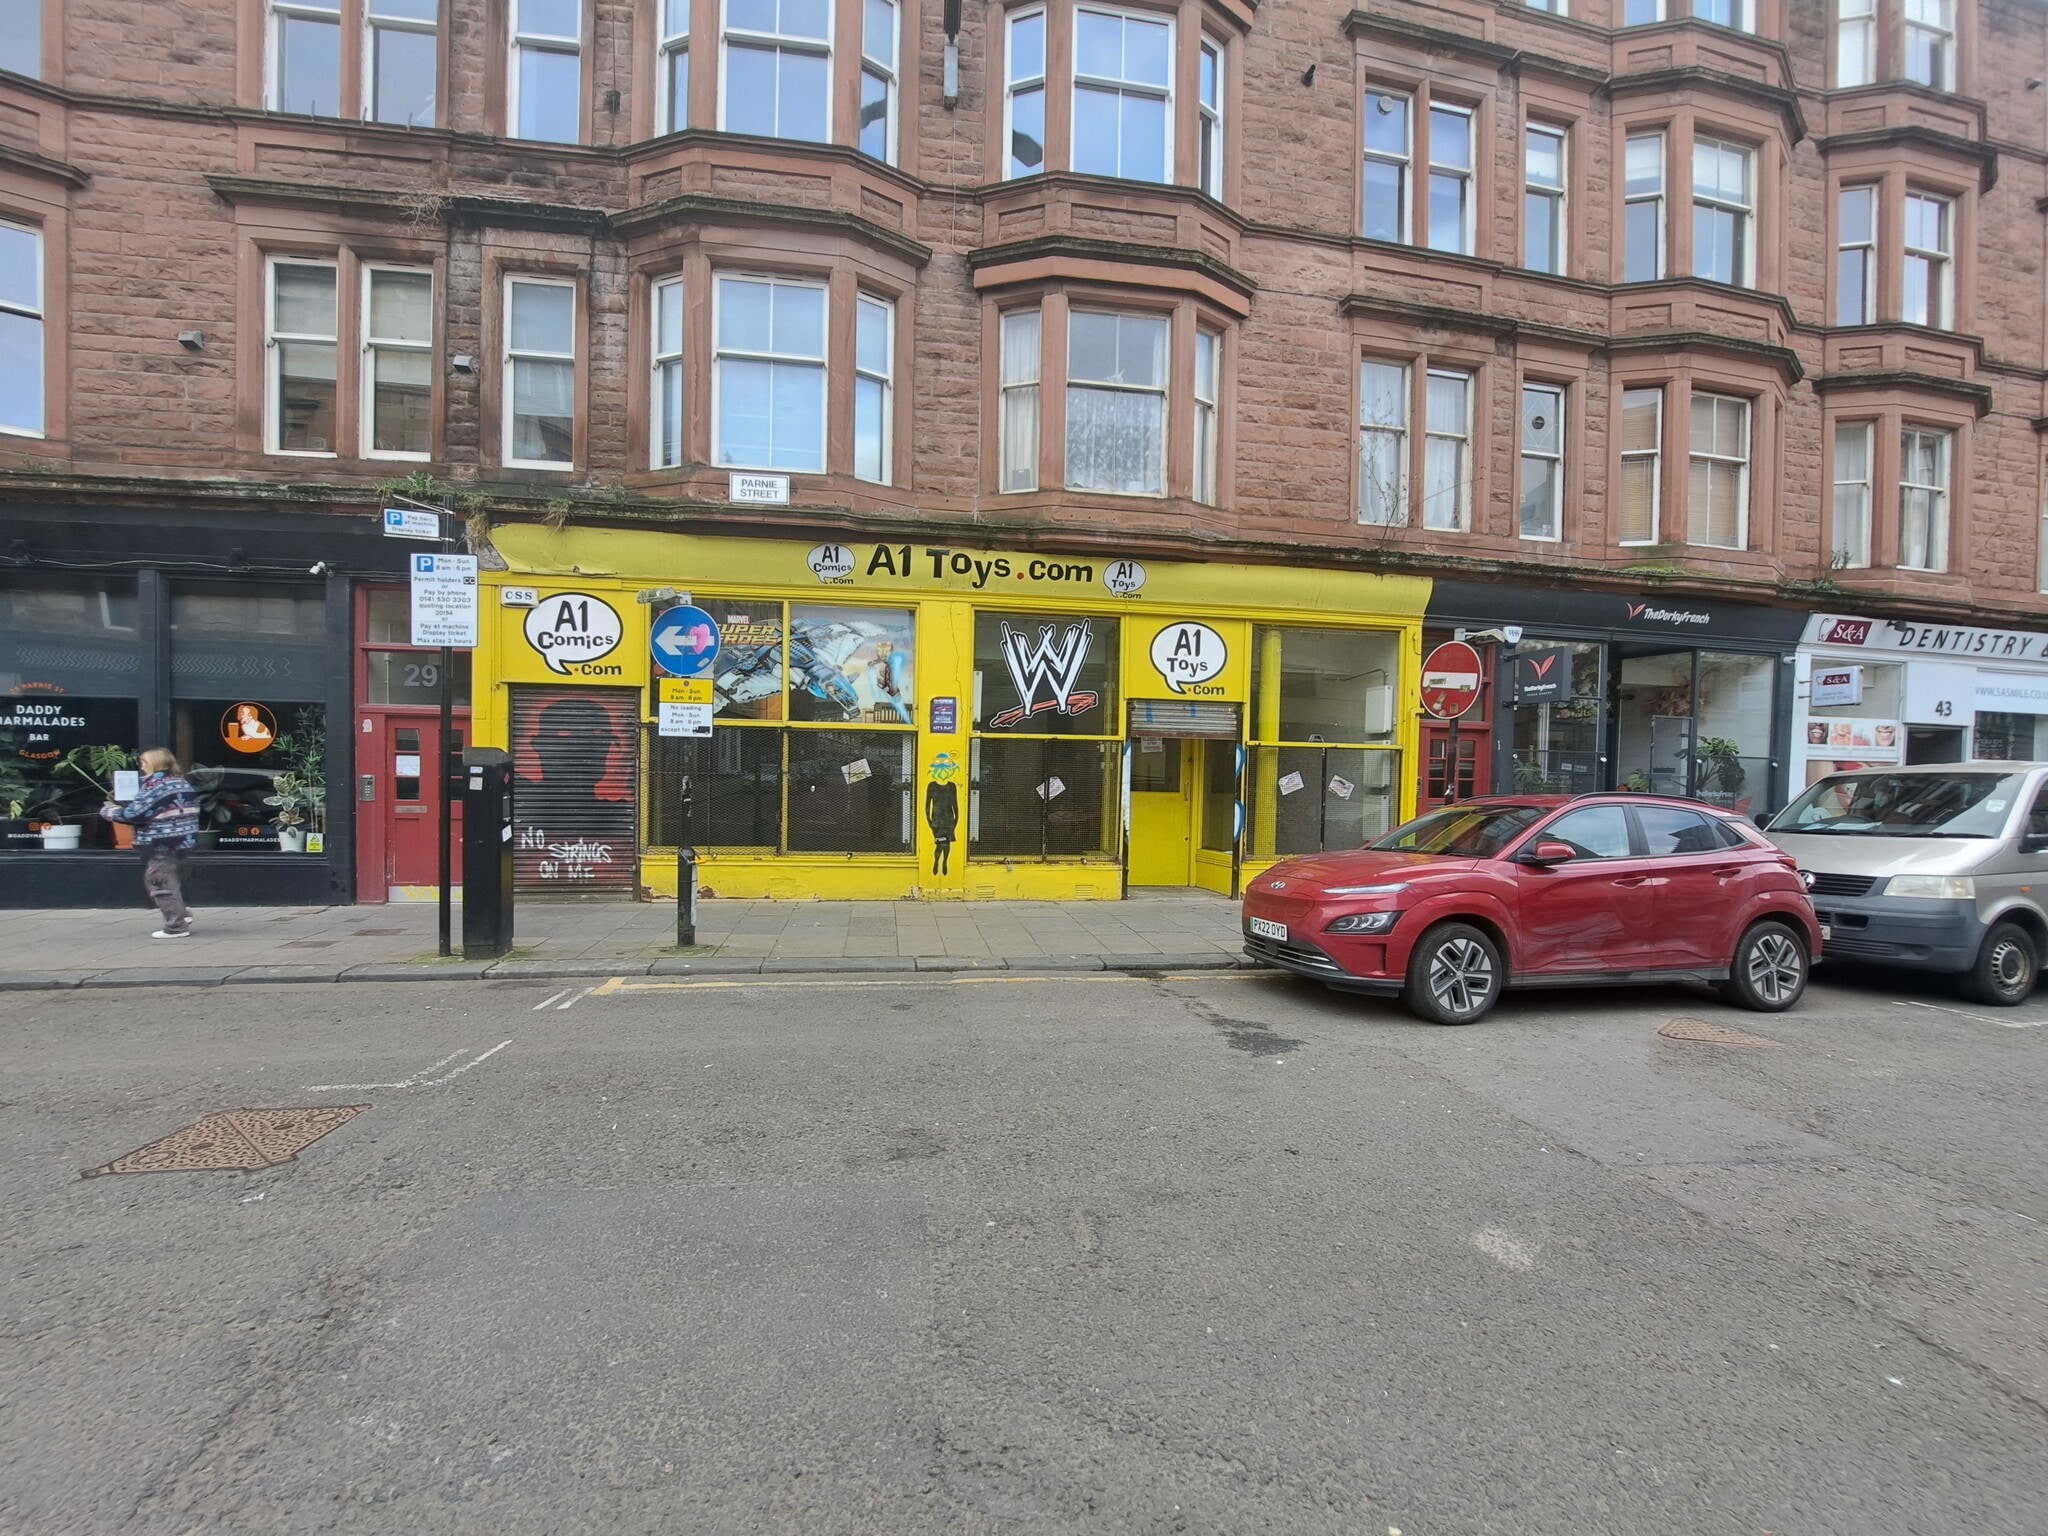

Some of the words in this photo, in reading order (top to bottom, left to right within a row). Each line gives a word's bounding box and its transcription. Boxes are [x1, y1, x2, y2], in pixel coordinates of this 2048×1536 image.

[741, 479, 777, 489] PARNIE
[740, 489, 779, 499] STREET
[822, 545, 839, 563] A1
[866, 544, 912, 577] A1
[813, 563, 852, 573] Comics
[1116, 562, 1133, 579] A1
[1112, 579, 1136, 590] Toys
[555, 600, 588, 632] A1
[727, 614, 750, 624] MARVEL
[537, 631, 614, 650] Comics
[1833, 624, 1864, 642] S&A
[1898, 627, 2033, 656] DENTISTRY
[1174, 628, 1201, 657] A1
[403, 663, 438, 687] 29
[1166, 657, 1208, 678] Toys
[16, 704, 62, 715] DADDY
[1935, 700, 1952, 717] 43
[29, 733, 49, 741] BAR
[19, 749, 61, 759] GLASGOW
[521, 826, 545, 849] NO
[1254, 919, 1270, 934] PX22
